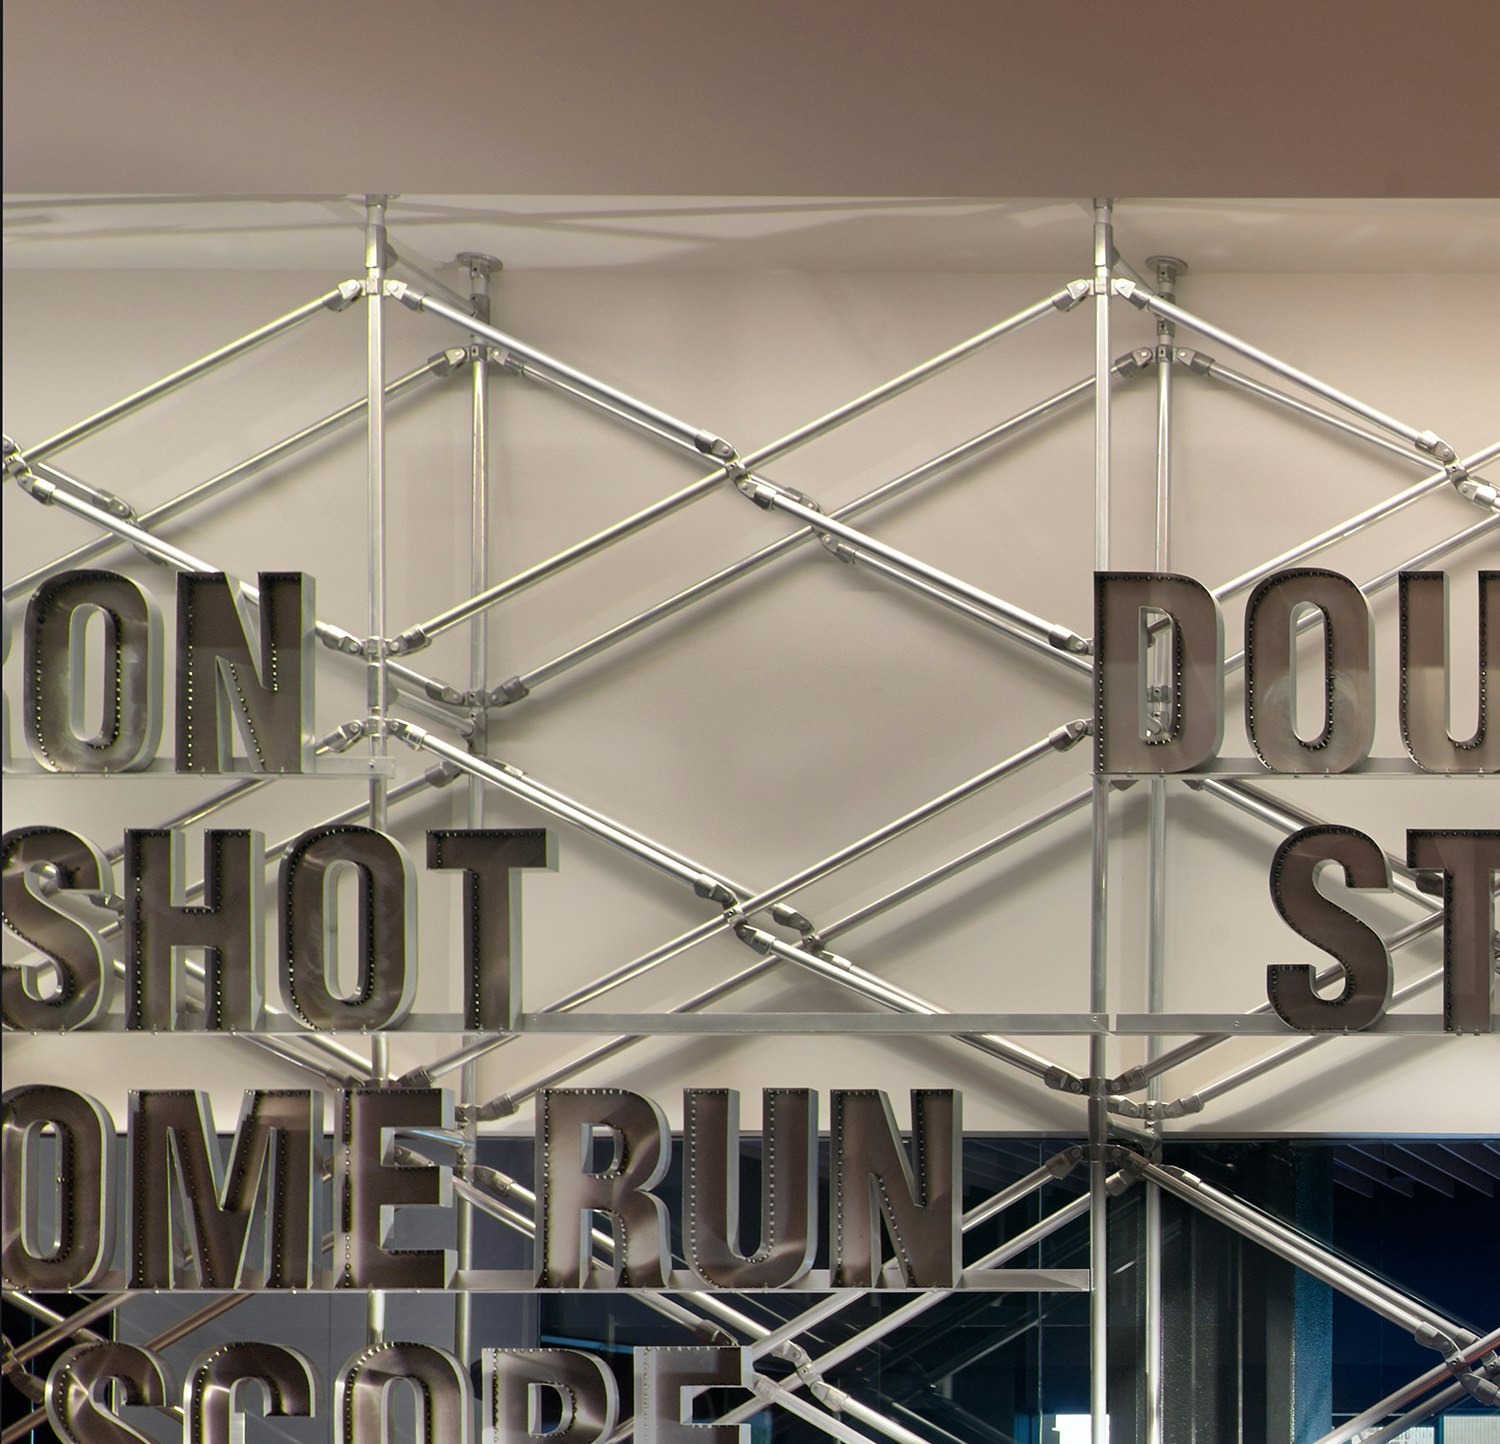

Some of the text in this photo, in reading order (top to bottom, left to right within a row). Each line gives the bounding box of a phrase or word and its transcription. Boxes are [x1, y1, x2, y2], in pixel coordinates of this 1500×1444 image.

[3, 569, 316, 774] ON
[2, 825, 560, 1032] SHOT
[2, 1084, 963, 1291] OME RUN
